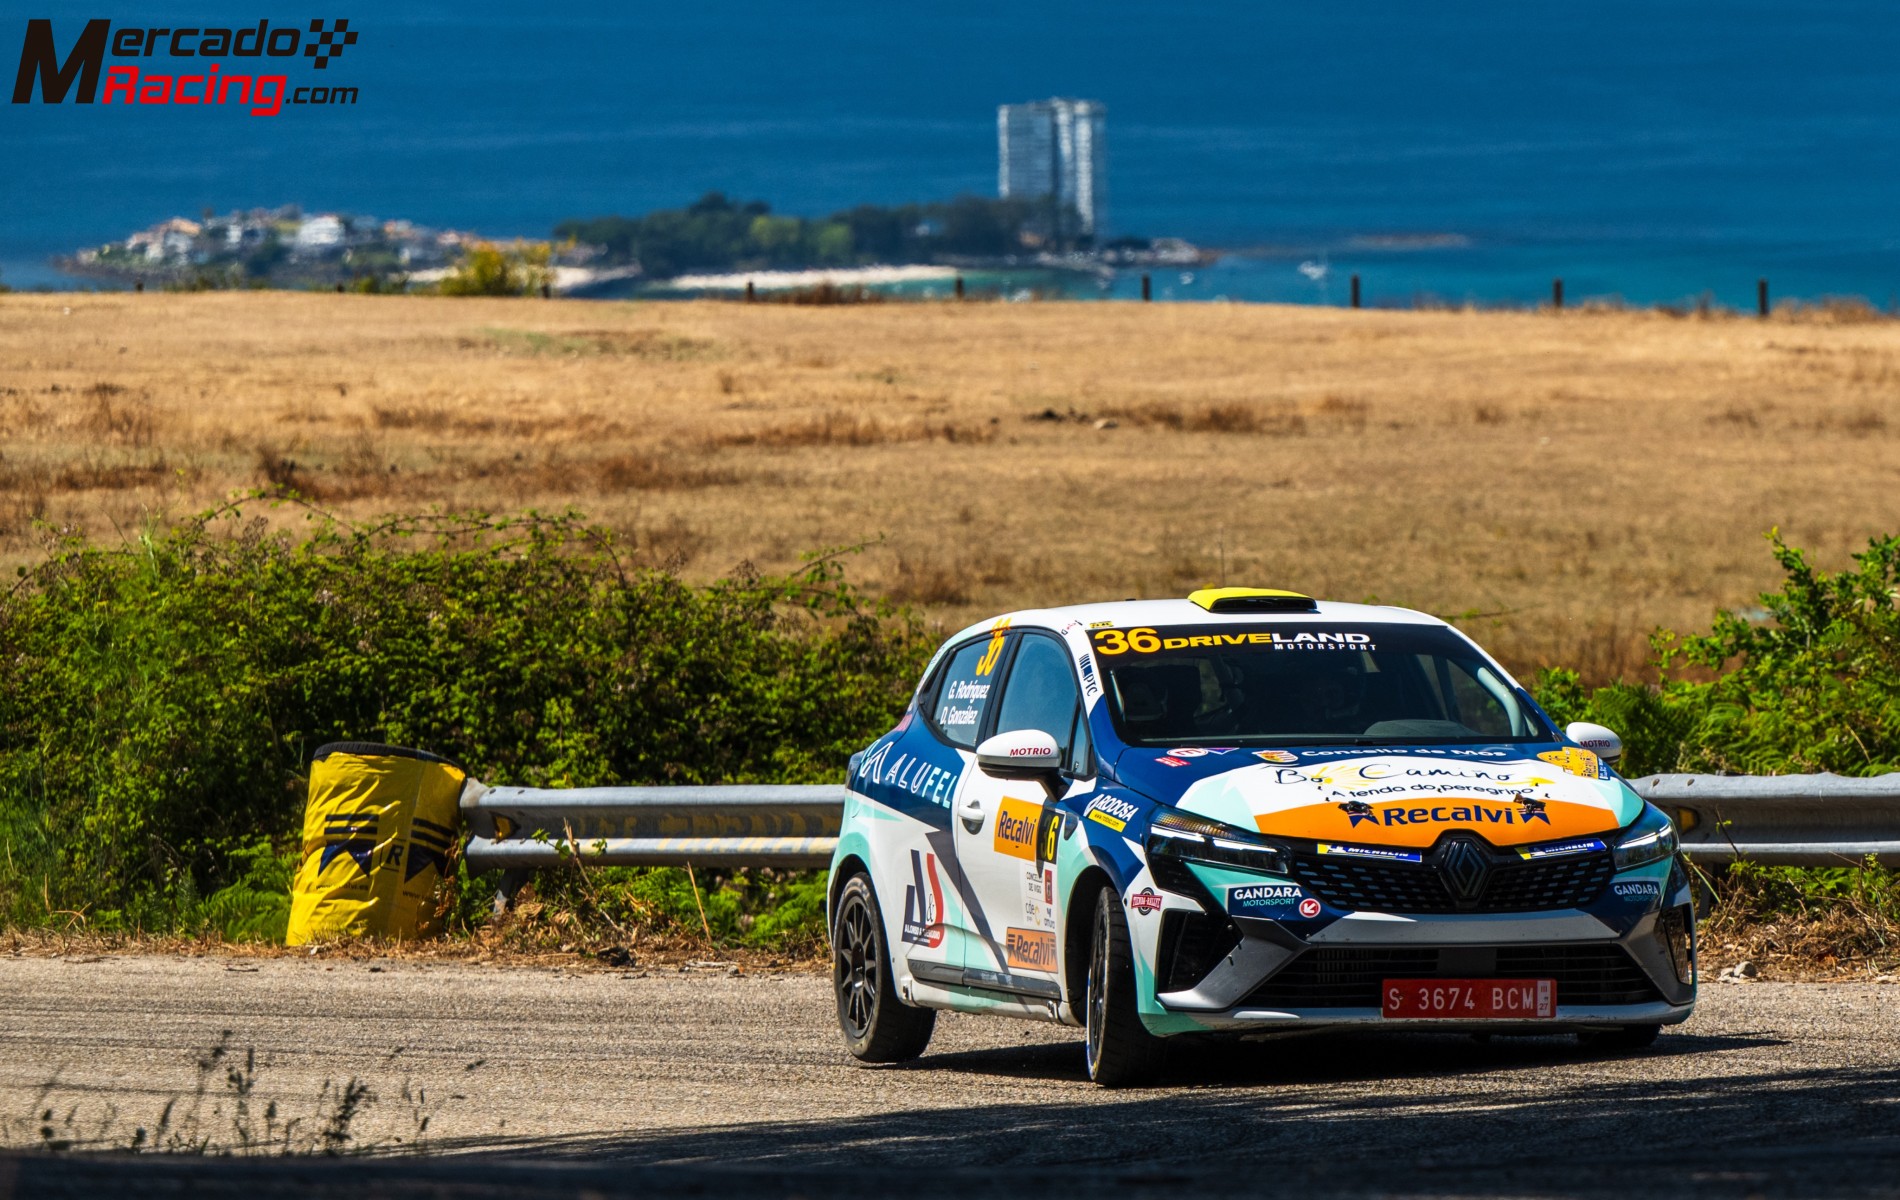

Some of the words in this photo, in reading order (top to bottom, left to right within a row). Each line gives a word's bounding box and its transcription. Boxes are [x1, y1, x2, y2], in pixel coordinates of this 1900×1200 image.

[1094, 627, 1161, 655] 36
[1163, 633, 1371, 650] DRIVELAND
[1274, 643, 1377, 651] MOTORSPORT
[1580, 740, 1611, 748] MOTRIO
[1009, 747, 1051, 757] MOTRIO
[1301, 748, 1408, 757] Concello
[1450, 749, 1507, 757] Mos
[1349, 785, 1406, 798] tenda
[1410, 783, 1435, 792] do
[1441, 784, 1534, 796] peregrino
[1382, 804, 1516, 827] Recalvi
[997, 810, 1037, 847] Recalvi
[1234, 886, 1302, 900] GANDARA
[1613, 883, 1659, 896] GANDARA
[1242, 898, 1296, 908] MOTORSPORT
[1016, 934, 1051, 966] Recalvi
[1388, 987, 1401, 1010] S
[1418, 987, 1476, 1010] 3674
[1492, 987, 1534, 1010] BCM
